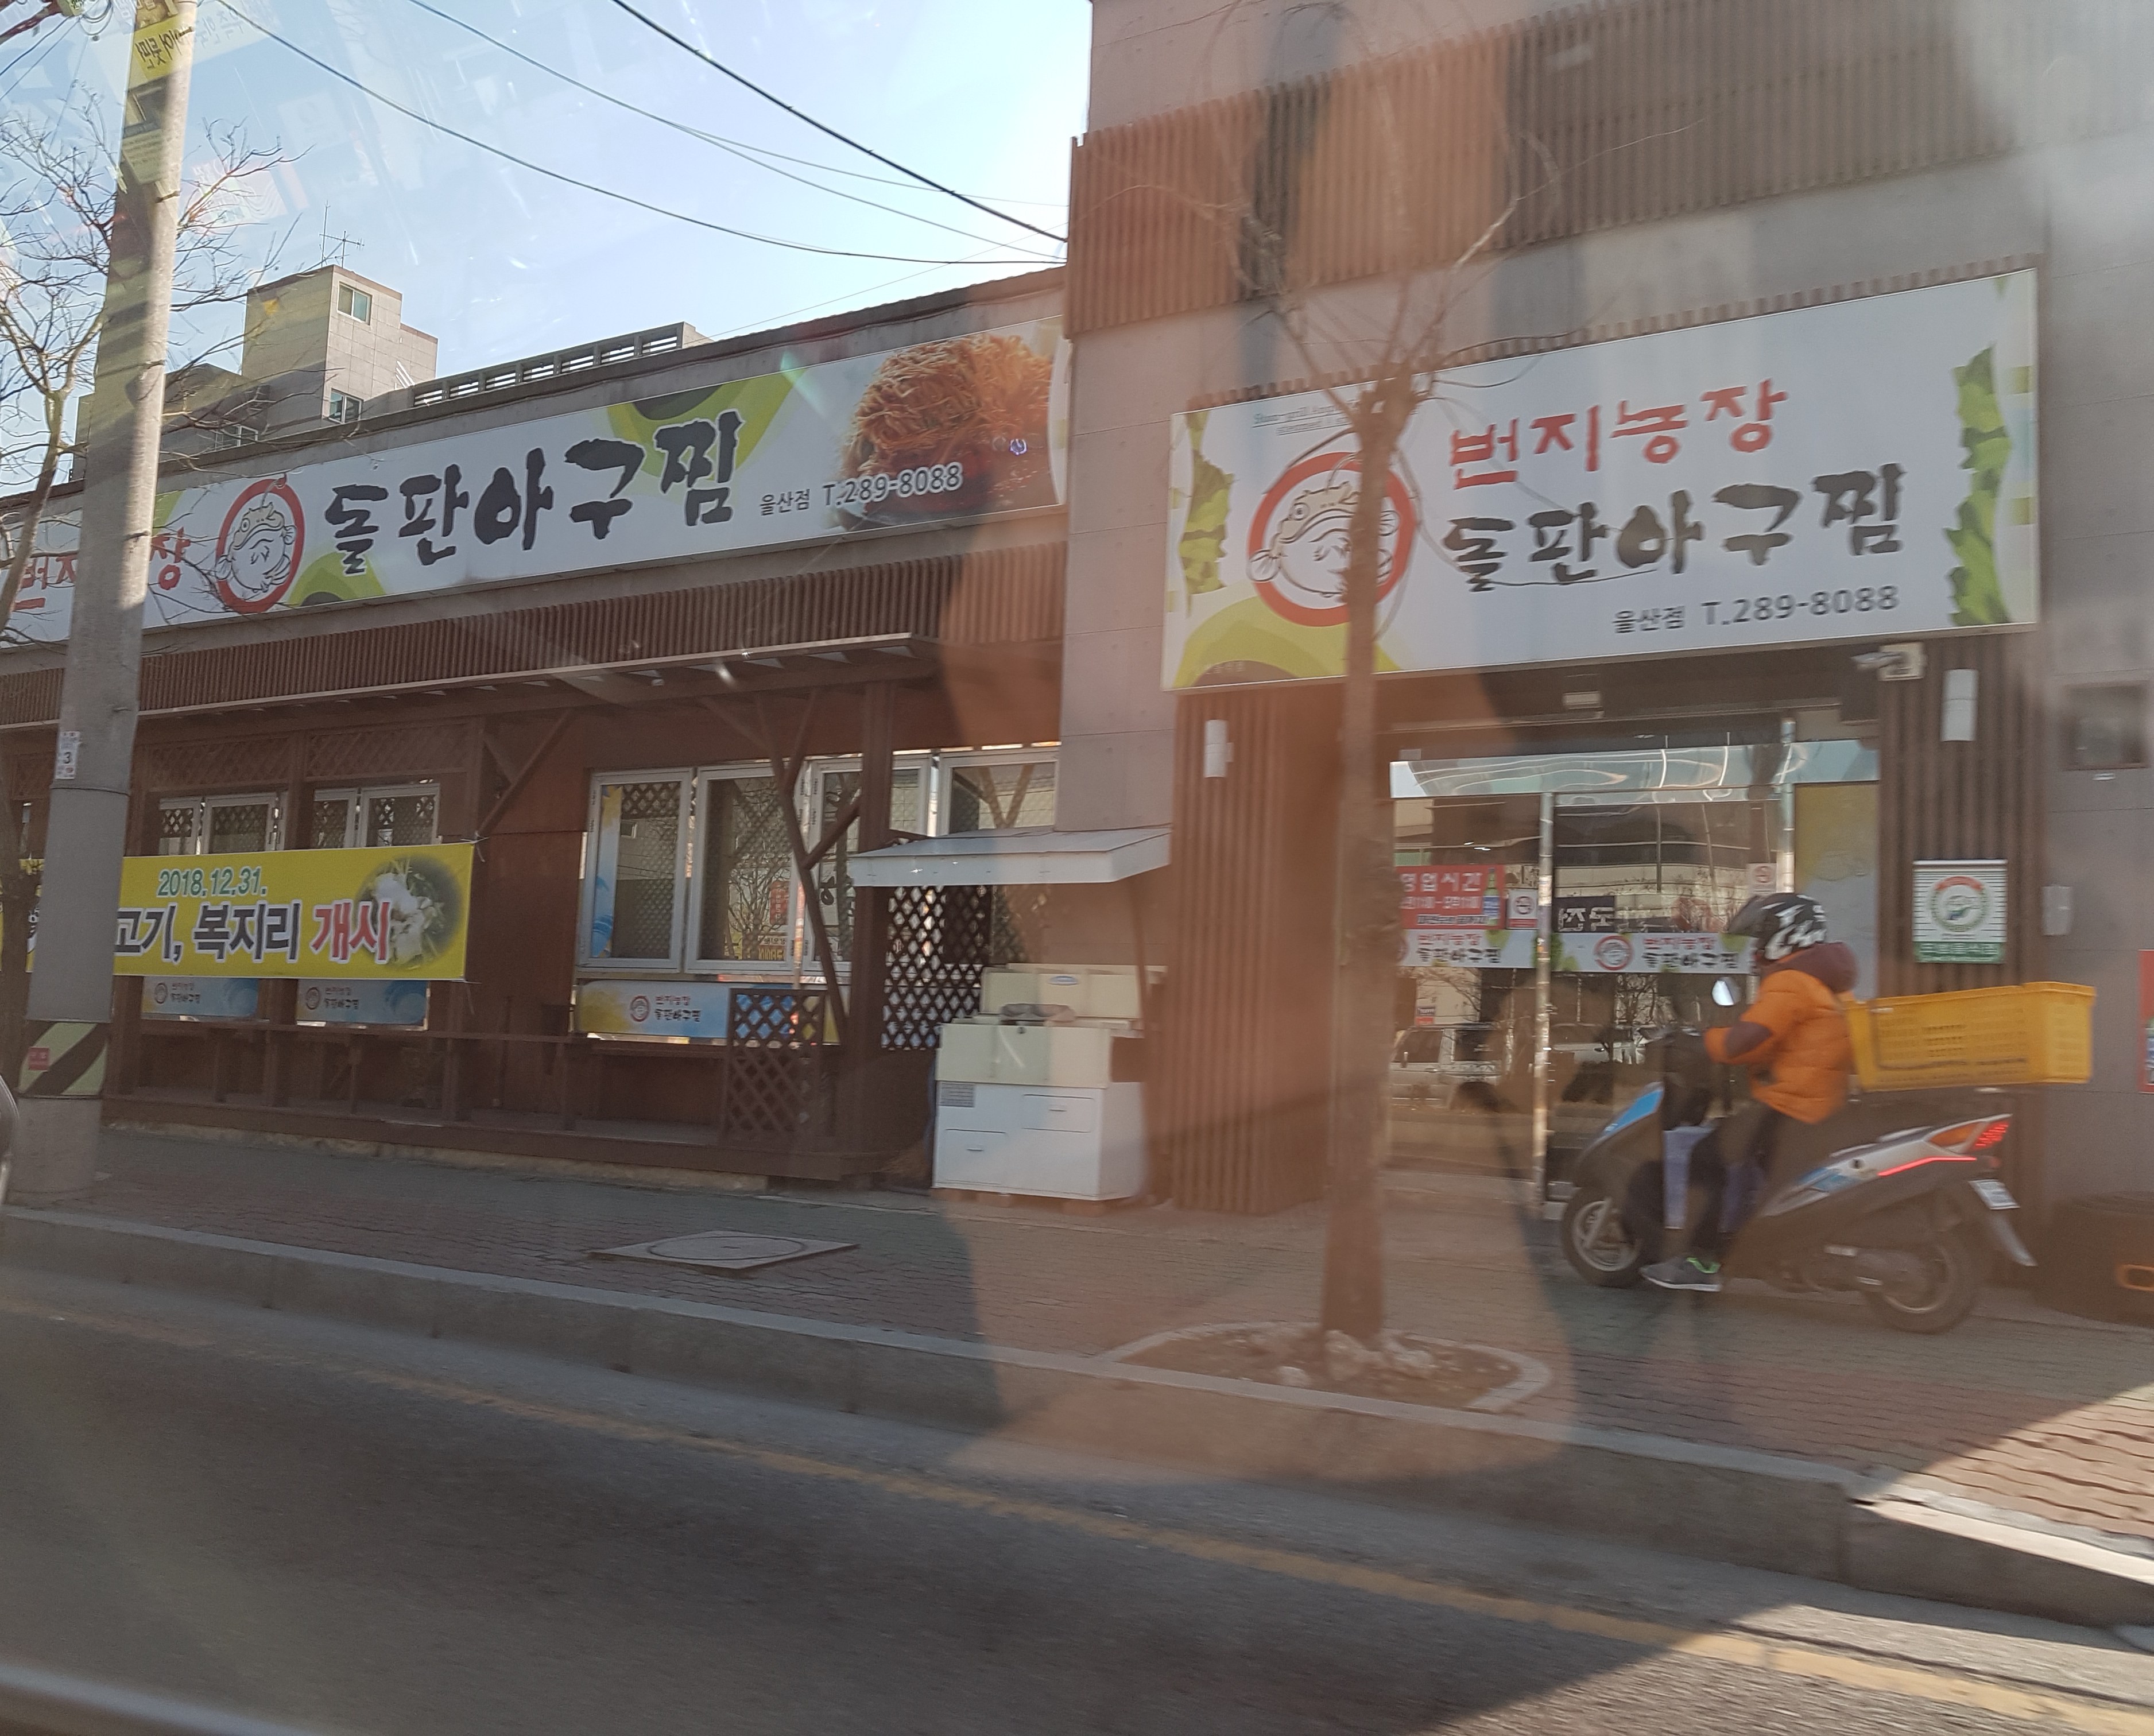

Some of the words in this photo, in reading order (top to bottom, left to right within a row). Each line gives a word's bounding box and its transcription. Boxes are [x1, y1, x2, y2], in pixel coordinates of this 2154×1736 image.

[1449, 378, 1789, 490] 번지농장
[324, 409, 744, 575] 돌판아구찜
[760, 489, 811, 517] 울산점
[822, 463, 961, 506] T.289-8088
[1442, 462, 1908, 592] 돌판아구찜
[1611, 605, 1686, 633] 울산점
[1700, 585, 1899, 626] T.289-8088
[157, 866, 268, 897] 2018.12.31.
[193, 902, 301, 962] 복지리
[311, 901, 391, 962] 개시
